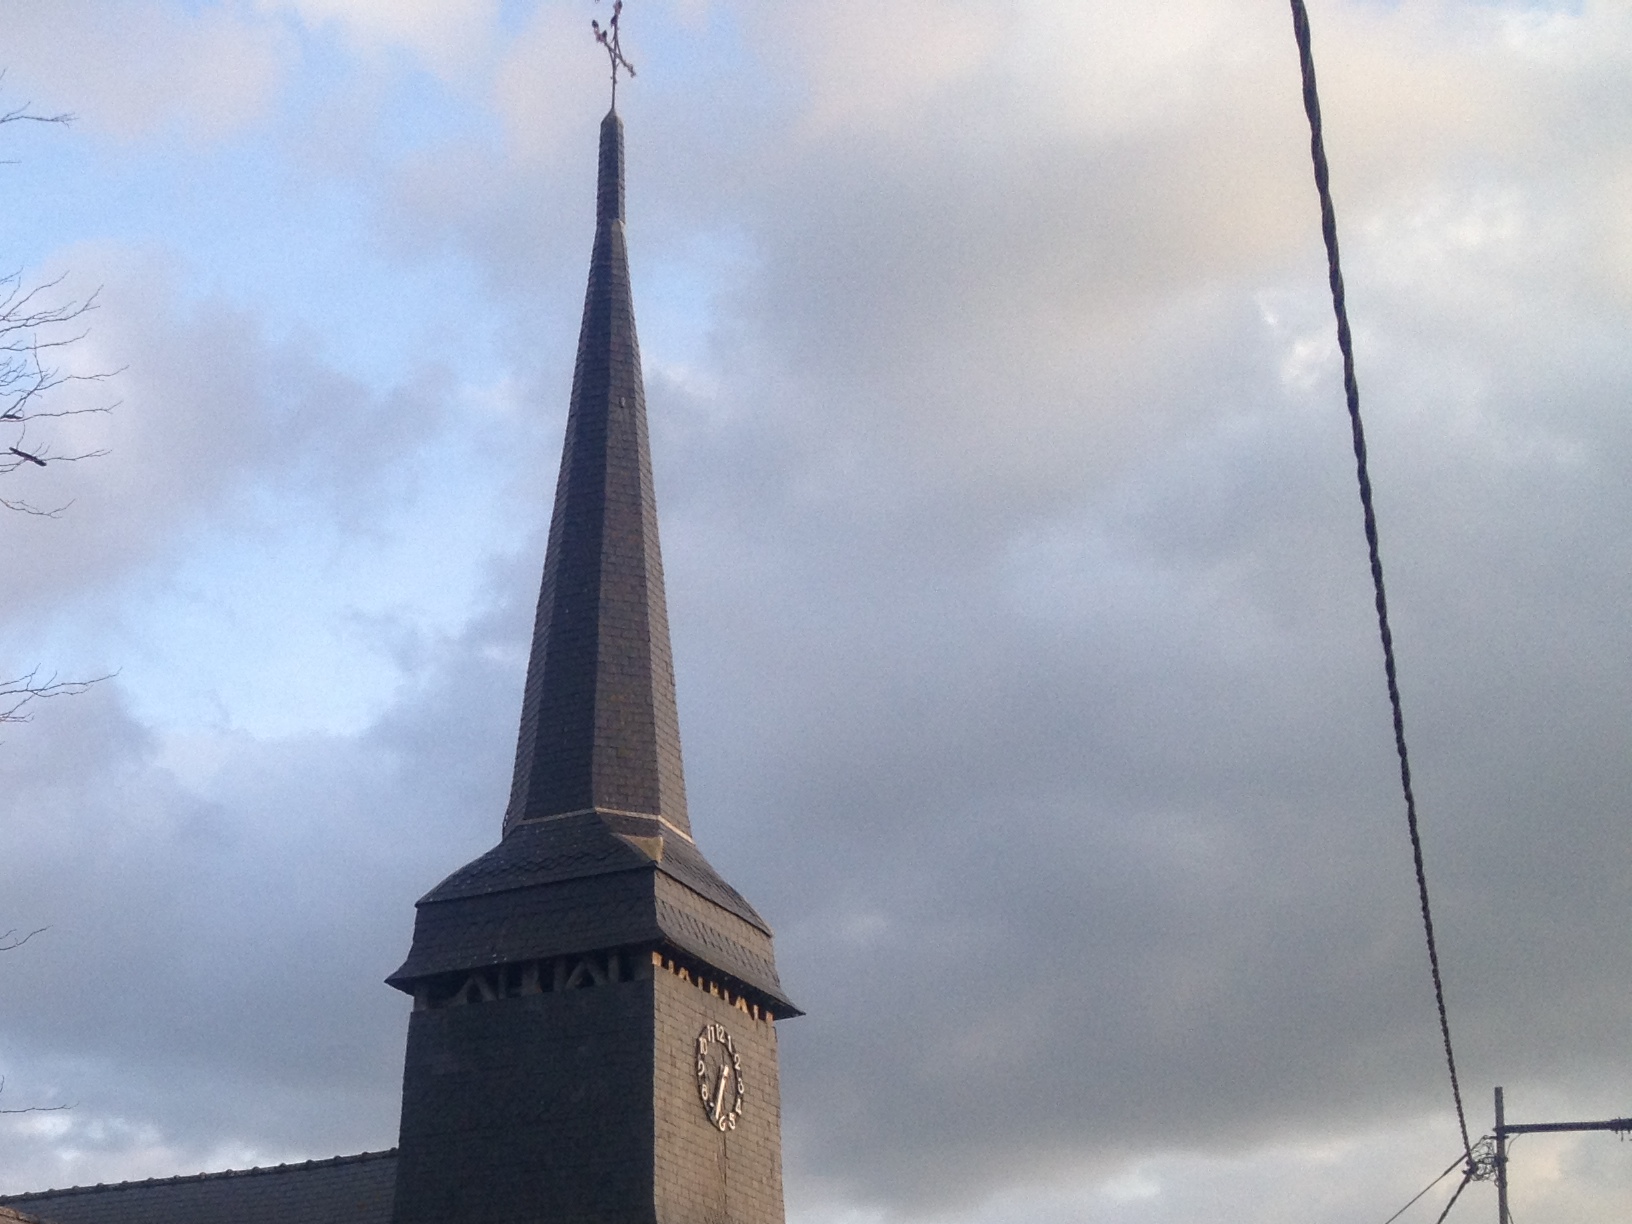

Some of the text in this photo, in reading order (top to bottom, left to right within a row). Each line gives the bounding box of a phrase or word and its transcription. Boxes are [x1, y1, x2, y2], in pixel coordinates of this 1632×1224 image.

[707, 1024, 716, 1043] 11
[715, 1023, 725, 1043] 12
[699, 1037, 708, 1055] 10
[727, 1035, 733, 1053] 1
[698, 1060, 705, 1076] 9
[734, 1054, 741, 1070] 2
[701, 1084, 709, 1100] 8
[737, 1077, 745, 1094] 3
[735, 1098, 742, 1115] 4
[718, 1115, 726, 1132] 6
[728, 1112, 736, 1130] 5
